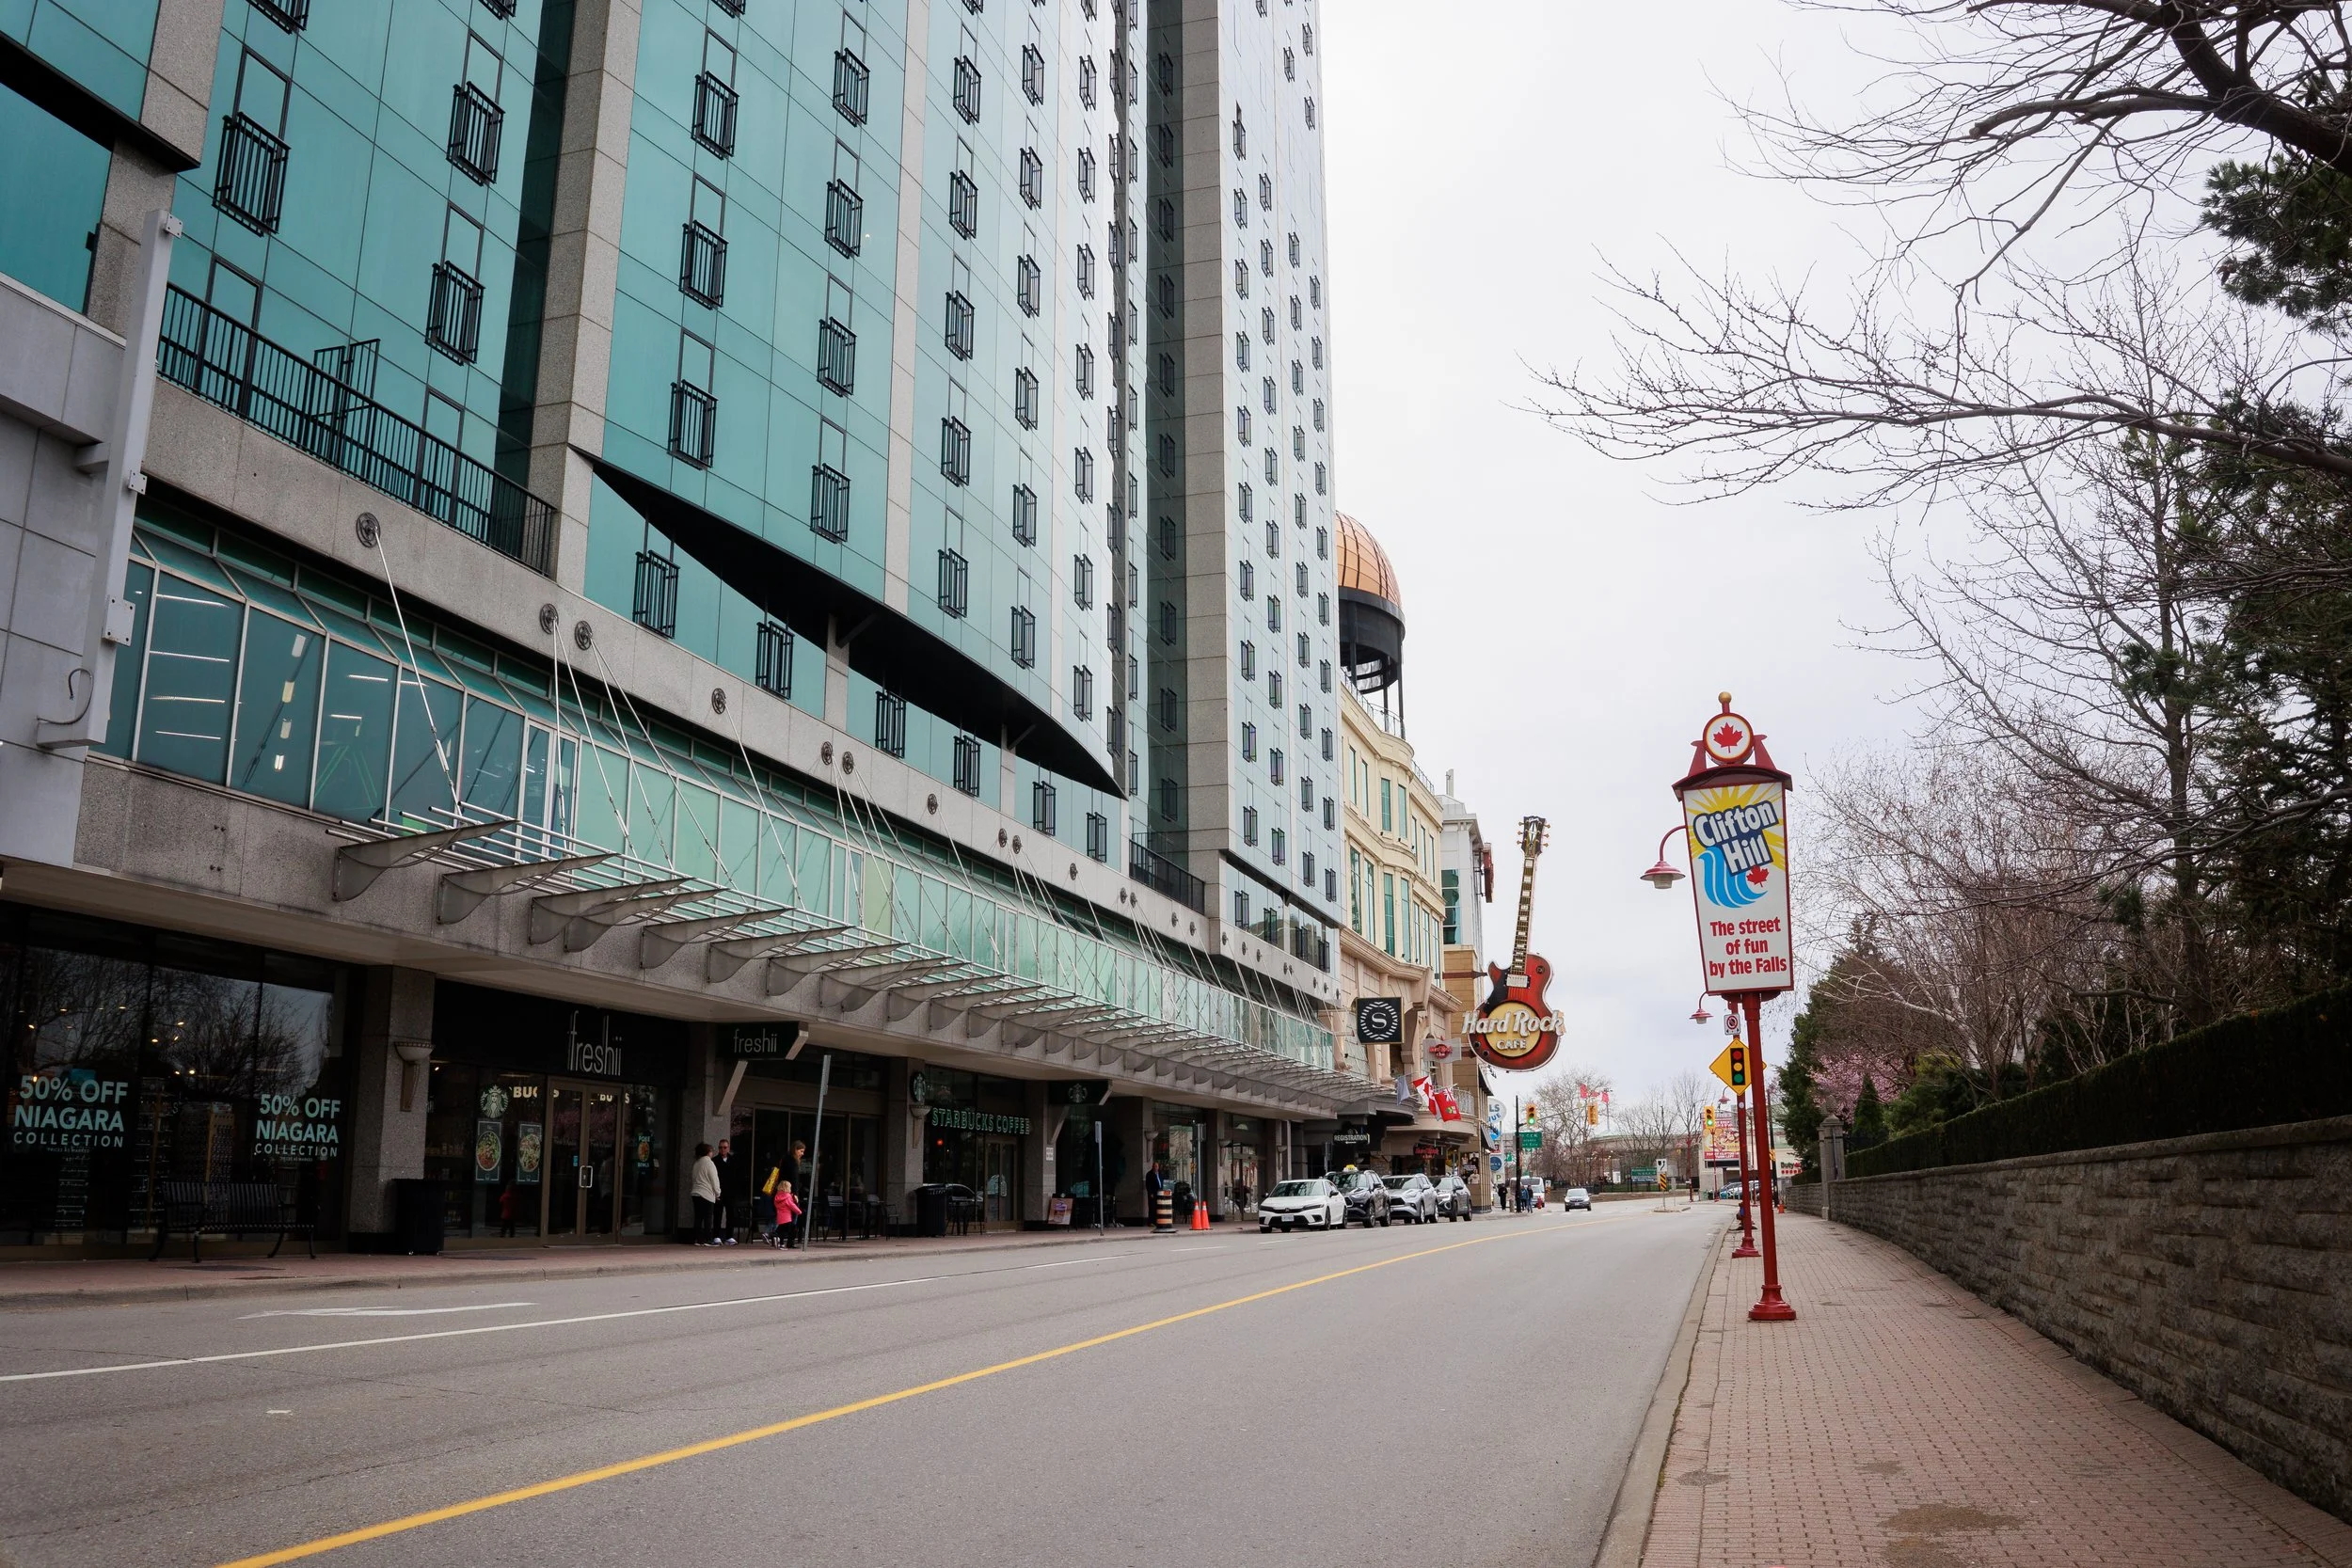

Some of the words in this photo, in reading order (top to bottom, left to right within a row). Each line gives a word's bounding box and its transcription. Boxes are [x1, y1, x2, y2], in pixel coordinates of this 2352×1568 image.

[1694, 801, 1777, 847] Clifton
[1722, 833, 1772, 875] Hill
[1709, 919, 1735, 937] The
[1739, 916, 1781, 935] street
[1725, 938, 1741, 955] of
[1743, 937, 1769, 954] fun
[1708, 960, 1725, 979] by
[1728, 958, 1753, 975] the
[1755, 956, 1788, 973] Falls
[1461, 1010, 1511, 1036] Hard
[1512, 1008, 1567, 1037] Rock
[567, 1010, 623, 1077] freshii
[733, 1028, 777, 1053] freshii
[1496, 1038, 1527, 1051] CAFE
[19, 1074, 72, 1101] 50%
[80, 1079, 129, 1104] OFF
[14, 1104, 125, 1132] NIAGARA
[259, 1093, 299, 1117] 50%
[304, 1097, 341, 1118] OFF
[256, 1119, 339, 1144] NIAGARA
[931, 1106, 993, 1132] STARBUCKS
[996, 1115, 1030, 1135] COFFEE
[13, 1132, 123, 1148] COLLECTION
[255, 1143, 338, 1157] COLLECTION
